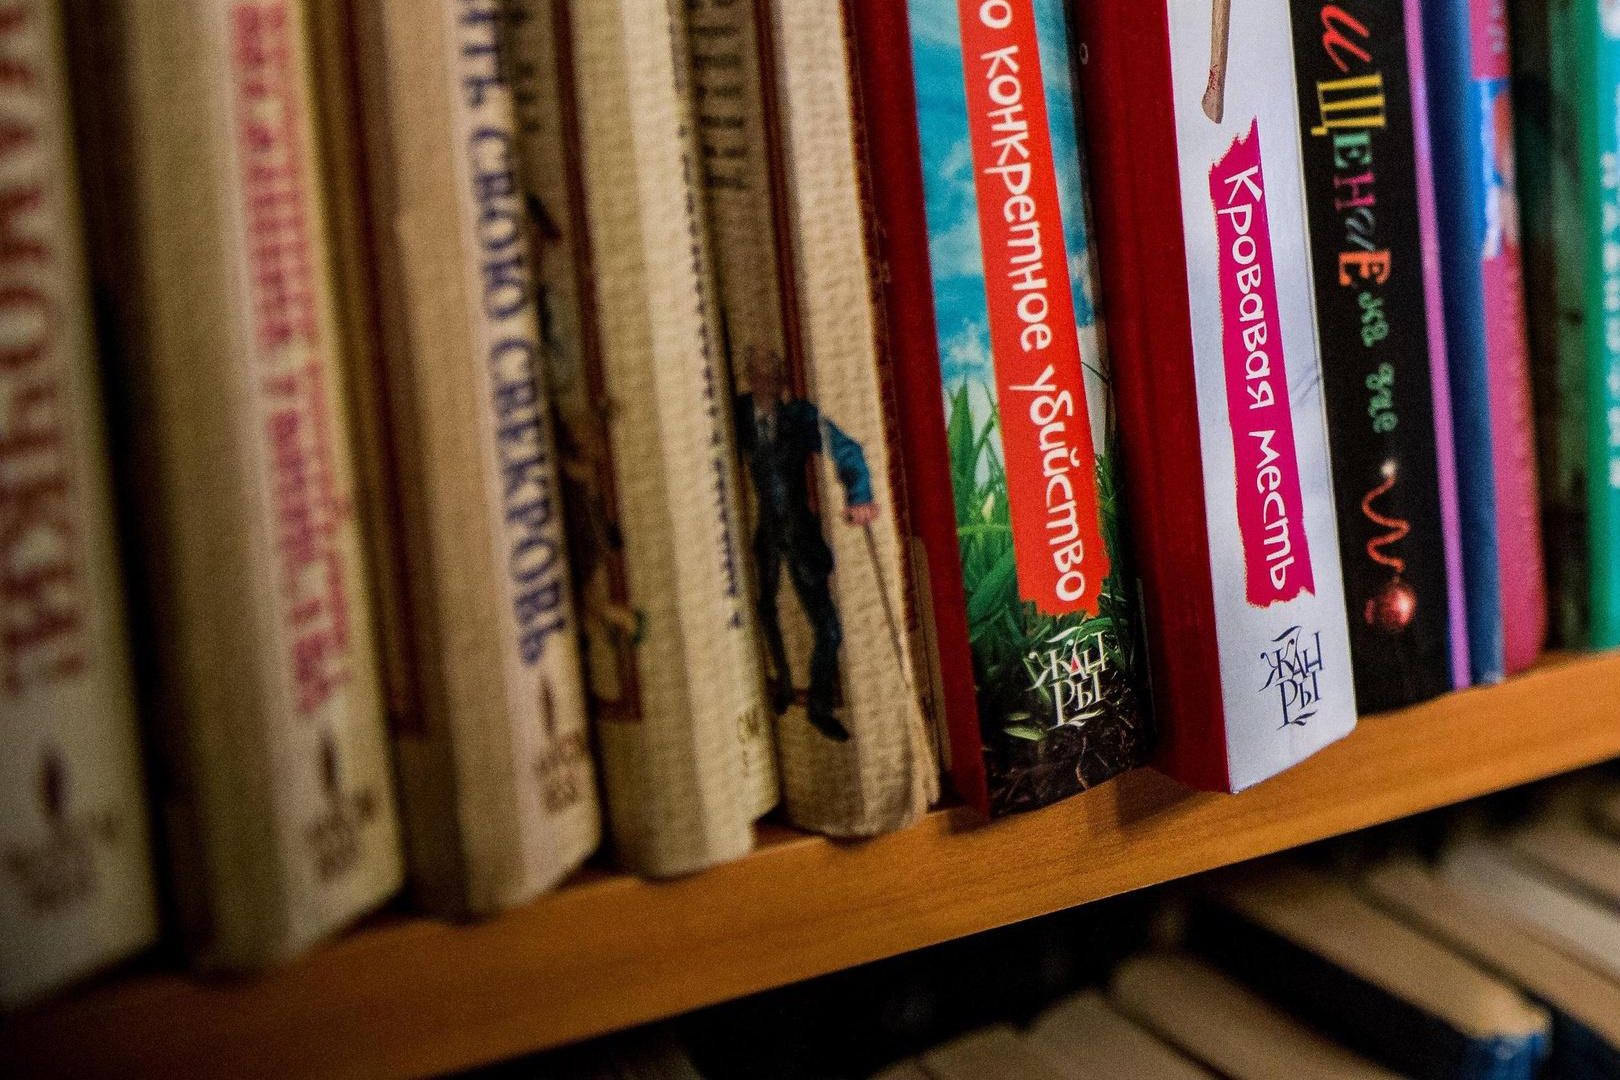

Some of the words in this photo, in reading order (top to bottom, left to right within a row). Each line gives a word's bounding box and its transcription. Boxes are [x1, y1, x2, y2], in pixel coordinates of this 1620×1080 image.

[980, 44, 1052, 352] конкретное
[487, 338, 568, 668] СВЕКРОВЬ
[1008, 365, 1087, 604] убийство
[1217, 165, 1275, 410] Кровавая
[1248, 428, 1296, 591] месть
